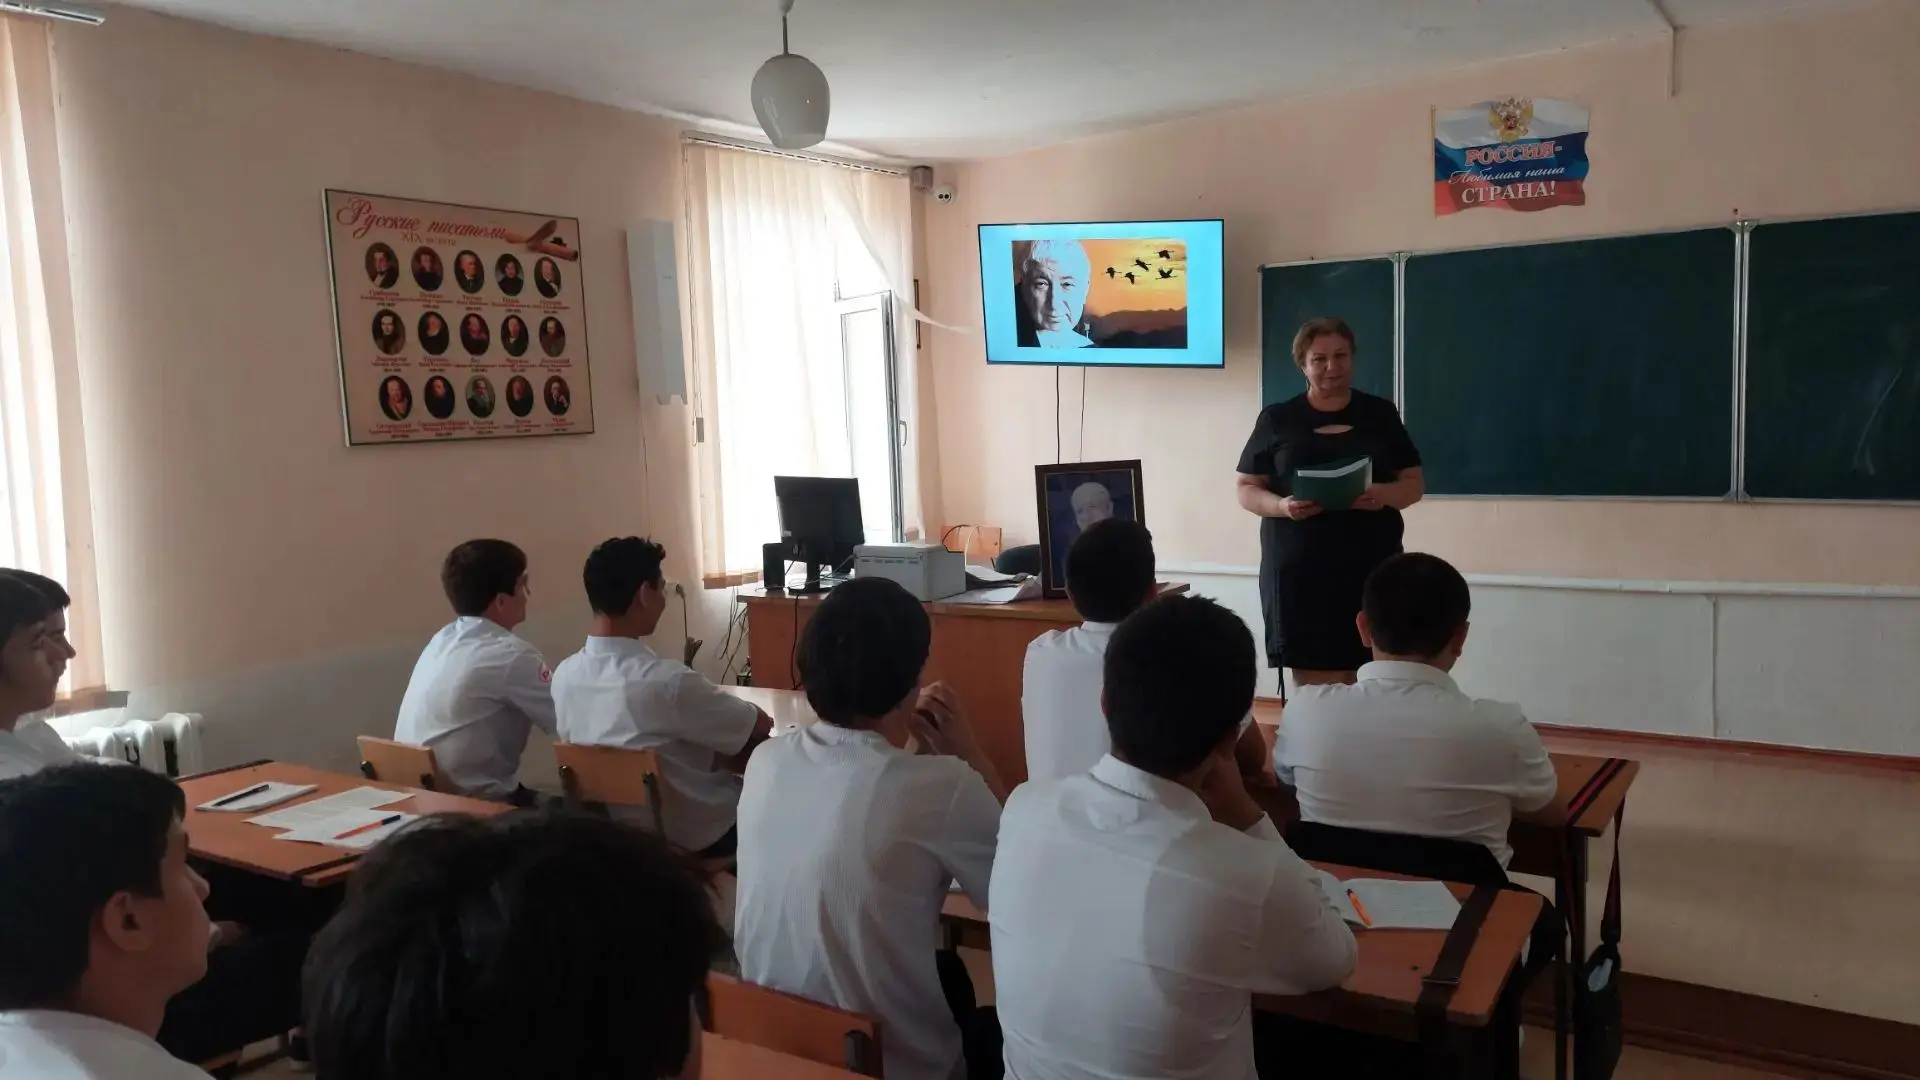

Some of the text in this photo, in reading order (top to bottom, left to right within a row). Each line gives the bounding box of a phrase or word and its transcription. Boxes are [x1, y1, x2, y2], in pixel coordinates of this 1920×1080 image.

[1465, 141, 1562, 166] РОССИЯ-
[1448, 166, 1566, 184] Любимая наша
[1461, 180, 1556, 204] СТРАНА!
[336, 199, 507, 241] Русские писатели
